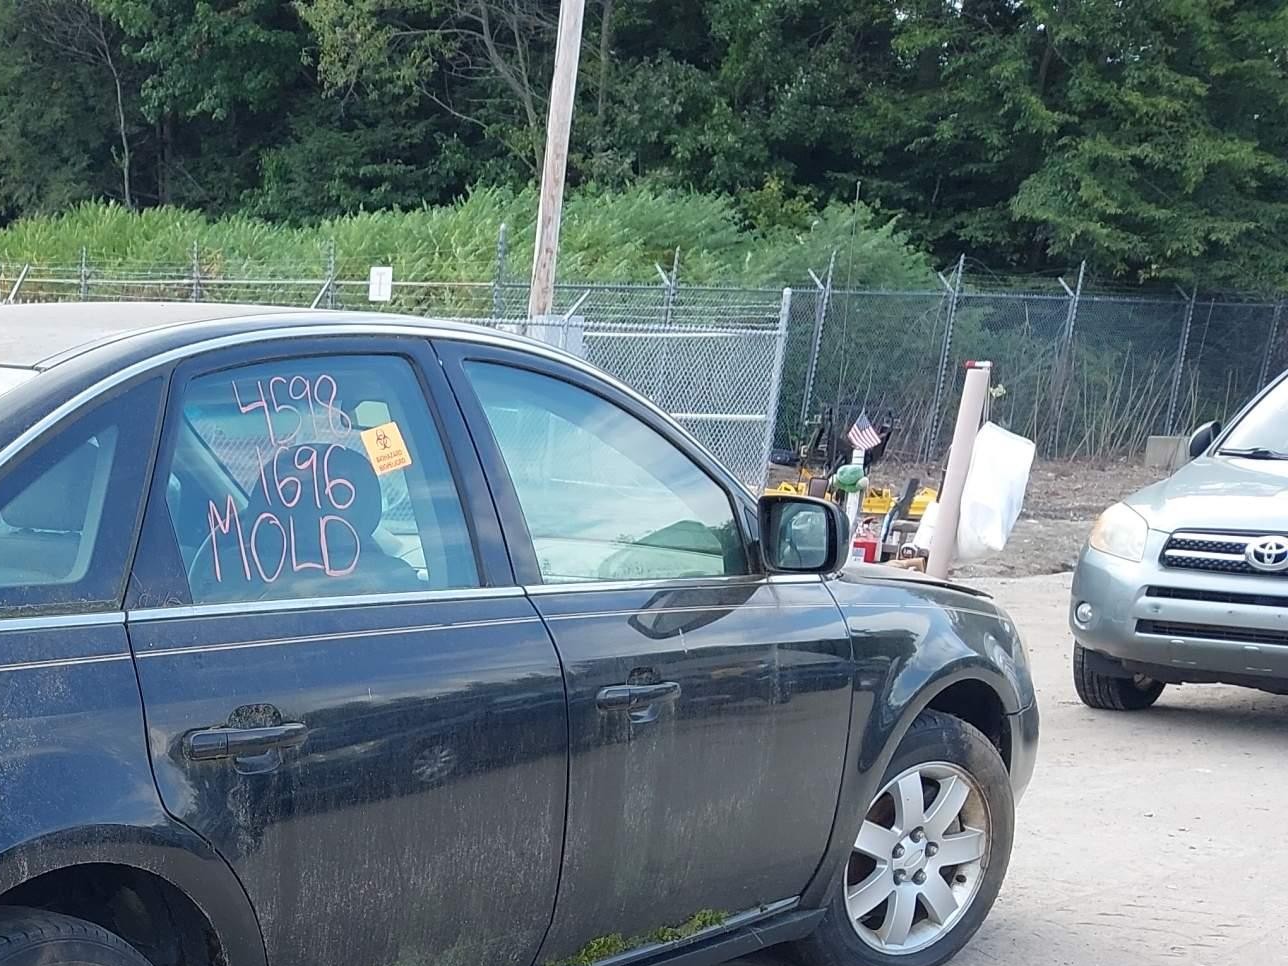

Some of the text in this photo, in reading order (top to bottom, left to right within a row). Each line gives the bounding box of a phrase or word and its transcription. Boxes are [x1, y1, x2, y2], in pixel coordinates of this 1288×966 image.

[231, 374, 353, 448] 4598
[256, 444, 356, 510] 1696
[207, 494, 361, 583] MOLD
